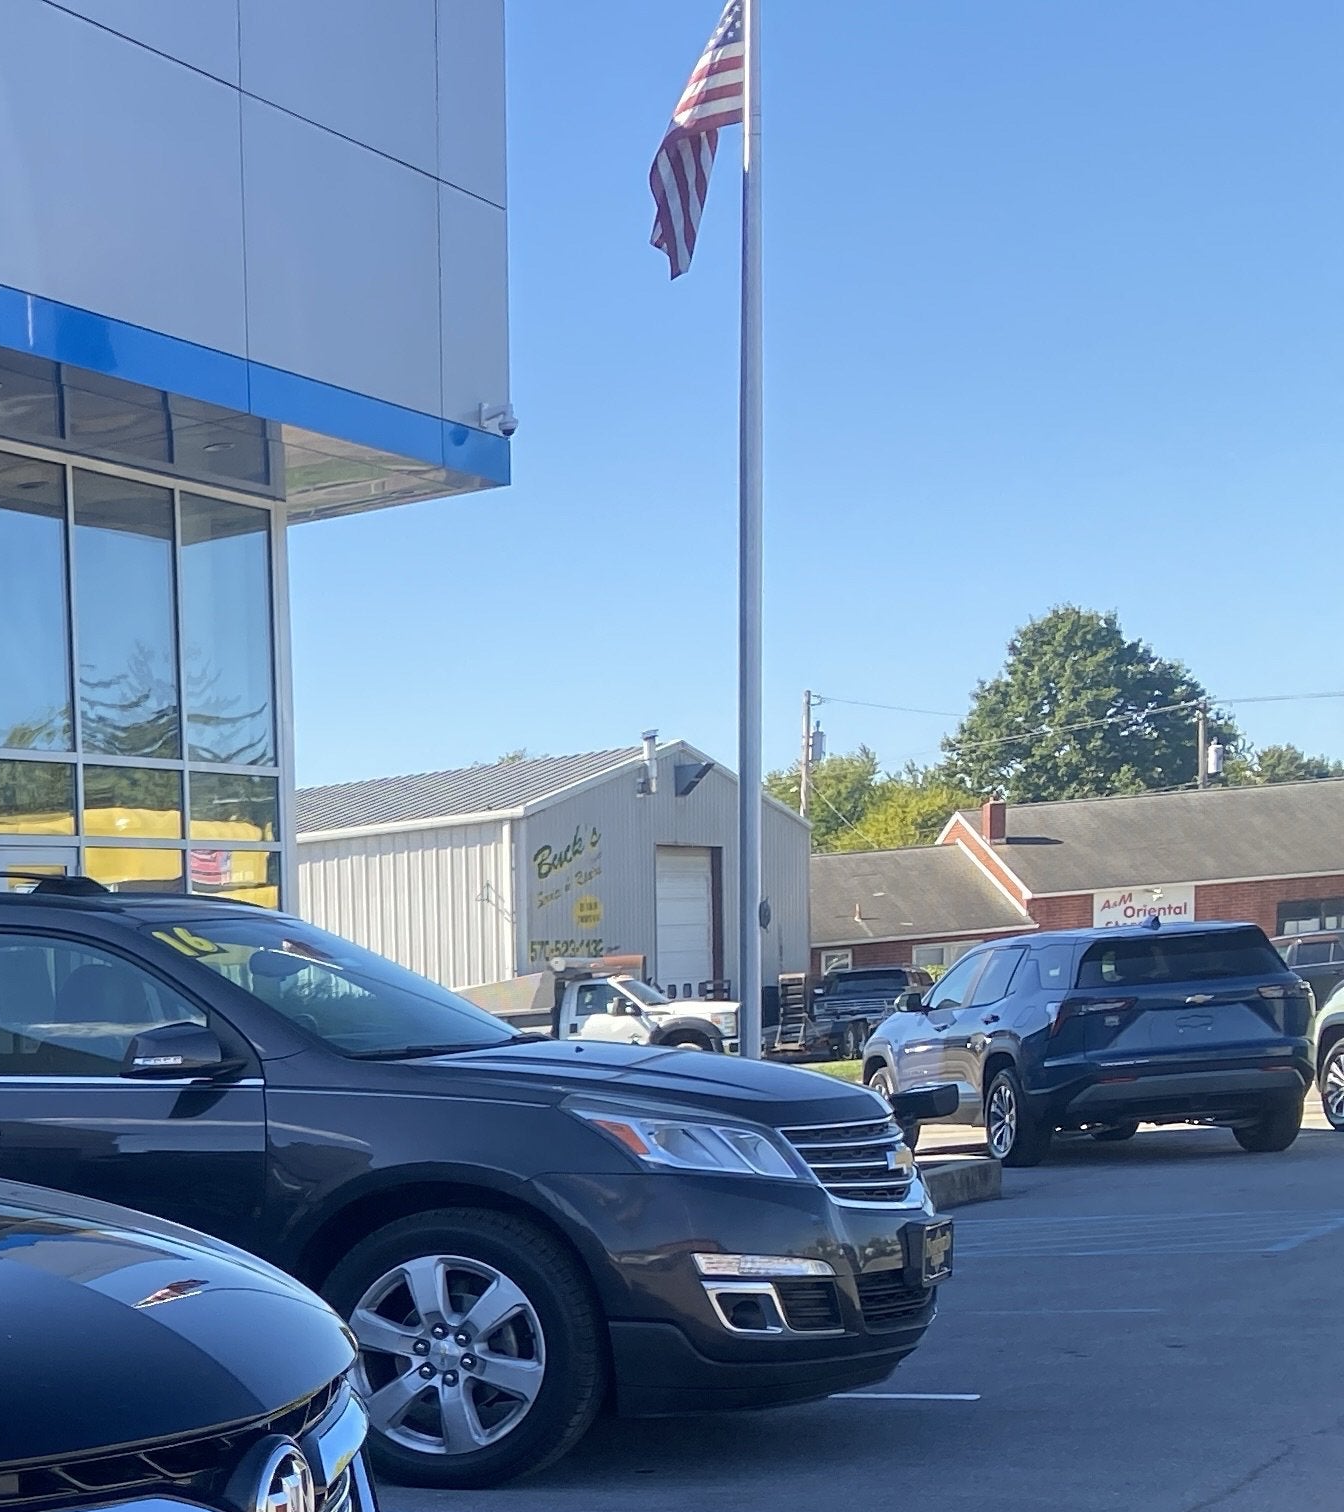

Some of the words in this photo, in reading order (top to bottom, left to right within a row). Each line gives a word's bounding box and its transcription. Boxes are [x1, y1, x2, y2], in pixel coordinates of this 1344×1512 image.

[533, 825, 602, 879] Buck's
[1101, 893, 1132, 911] A&M
[1123, 902, 1187, 918] Oriental
[152, 927, 218, 957] 16
